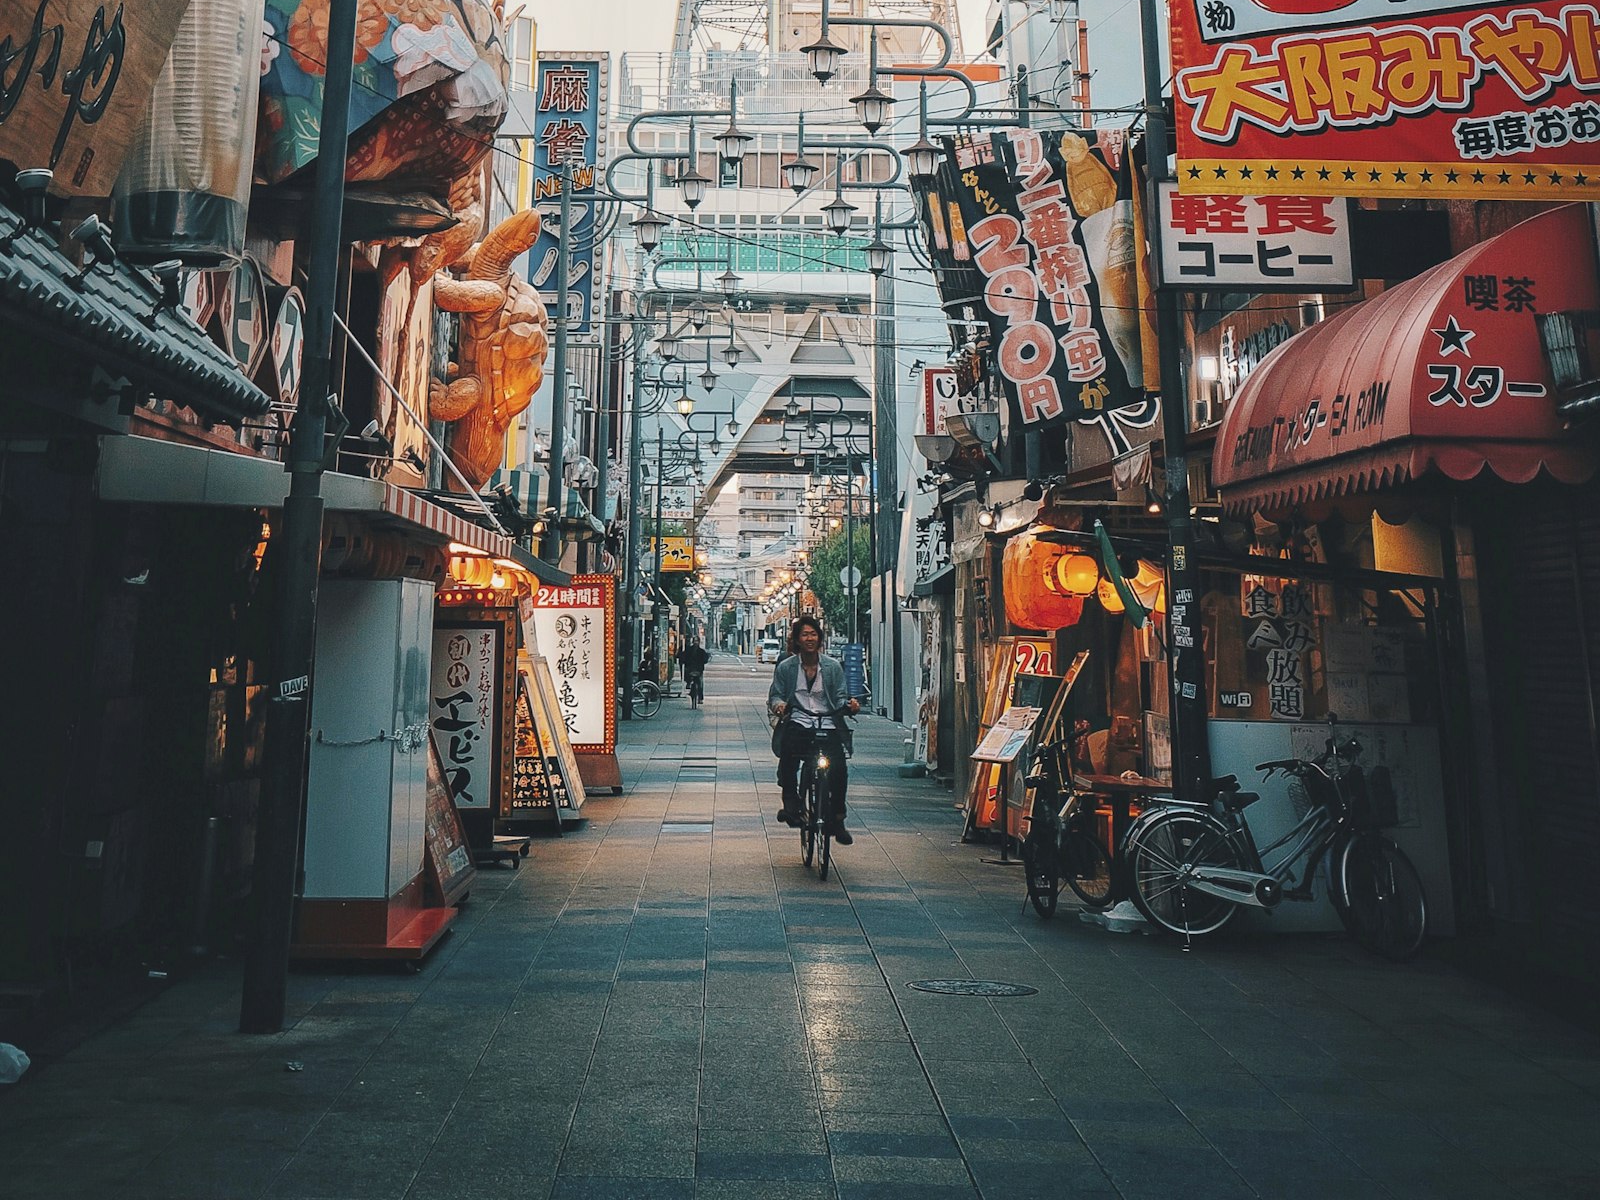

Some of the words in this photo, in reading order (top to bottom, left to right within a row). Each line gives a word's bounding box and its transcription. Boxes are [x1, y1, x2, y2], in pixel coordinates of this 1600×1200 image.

[537, 65, 590, 166] 麻雀
[1169, 194, 1337, 236] 軽食
[1178, 240, 1334, 278] コーヒー
[1464, 275, 1537, 313] 喫茶
[1427, 364, 1547, 408] スター
[537, 587, 592, 606] 24時間
[446, 634, 472, 689] 初代
[433, 690, 481, 803] エビス
